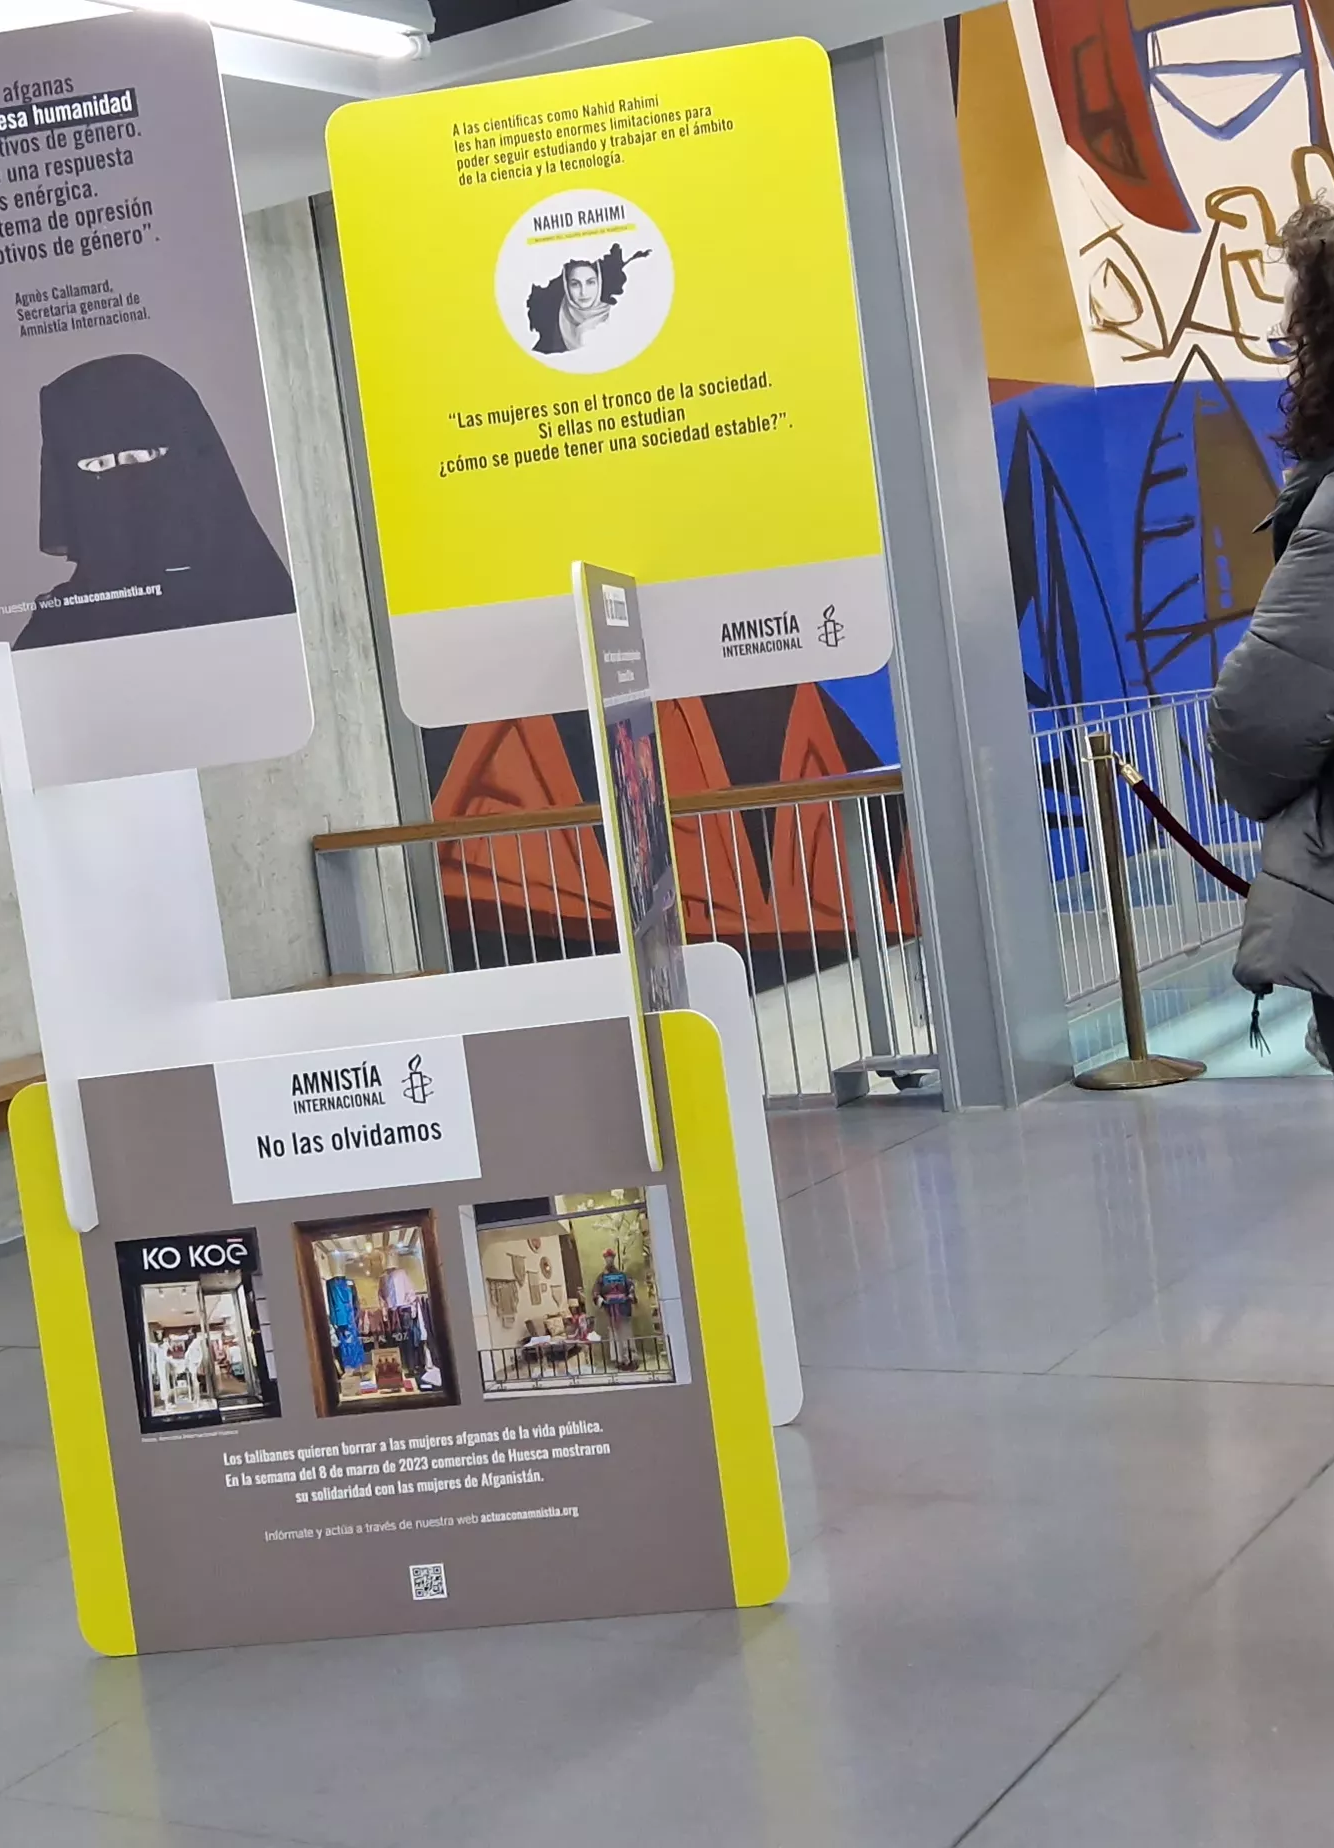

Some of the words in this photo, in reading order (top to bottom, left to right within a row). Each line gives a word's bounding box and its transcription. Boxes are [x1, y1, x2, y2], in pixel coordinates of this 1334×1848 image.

[2, 77, 74, 103] afganas
[32, 90, 132, 125] humanidad
[452, 123, 460, 136] A
[462, 121, 480, 135] las
[482, 113, 543, 132] científicas
[546, 108, 578, 122] como
[581, 100, 615, 117] Nahid
[618, 95, 659, 112] Rahimi
[45, 128, 67, 150] de
[72, 122, 141, 150] género.
[453, 139, 471, 153] les
[474, 136, 496, 150] han
[499, 128, 552, 146] impuesto
[555, 121, 606, 138] enormes
[609, 110, 681, 130] limitaciones
[684, 105, 711, 122] para
[456, 154, 489, 172] poder
[493, 147, 529, 165] seguir
[532, 137, 597, 158] estudiando
[599, 138, 606, 151] y
[609, 130, 656, 147] trabajar
[660, 128, 675, 140] en
[678, 123, 689, 137] el
[693, 118, 733, 135] ámbito
[6, 163, 39, 183] una
[44, 146, 133, 177] respuesta
[458, 172, 472, 186] de
[475, 170, 487, 183] la
[489, 165, 532, 181] ciencia
[535, 164, 542, 177] y
[545, 160, 556, 173] la
[559, 153, 624, 171] tecnología.
[13, 182, 98, 208] enérgica.
[47, 209, 68, 230] de
[74, 198, 152, 229] opresión
[533, 212, 573, 231] NAHID
[577, 204, 625, 225] RAHIMI
[52, 235, 74, 256] de
[16, 303, 77, 321] Secretaría
[79, 292, 123, 314] general
[125, 291, 140, 305] de
[51, 279, 113, 300] Callamard,
[19, 319, 68, 337] Amnistía
[70, 306, 150, 330] Internacional.
[487, 404, 548, 425] mujeres
[552, 400, 579, 416] son
[583, 393, 597, 411] el
[601, 390, 652, 409] tronco
[656, 384, 675, 402] de
[679, 382, 693, 398] la
[698, 370, 772, 396] sociedad.
[538, 421, 552, 439] Si
[557, 418, 593, 437] ellas
[597, 417, 615, 431] no
[620, 406, 685, 428] estudian
[439, 454, 487, 477] ¿cómo
[491, 452, 509, 467] se
[513, 443, 559, 468] puede
[563, 440, 603, 457] tener
[608, 435, 636, 451] una
[641, 422, 709, 447] sociedad
[38, 596, 61, 609] web
[62, 583, 162, 606] actuaconamnistia.org
[721, 610, 800, 642] AMNISTÍA
[722, 636, 802, 658] INTERNACIONAL
[291, 1060, 382, 1096] AMNISTÍA
[292, 1091, 385, 1114] INTERNACIONAL
[256, 1134, 285, 1158] No
[291, 1131, 324, 1155] las
[331, 1121, 441, 1150] olvidamos
[142, 1246, 180, 1269] KO
[222, 1452, 242, 1466] Los
[243, 1448, 295, 1464] talibanes
[296, 1444, 339, 1461] quieren
[340, 1441, 377, 1455] borrar
[378, 1440, 387, 1452] a
[388, 1437, 406, 1451] las
[407, 1434, 453, 1449] mujeres
[455, 1430, 500, 1446] afganas
[501, 1426, 516, 1440] de
[518, 1424, 529, 1439] la
[531, 1423, 556, 1438] vida
[557, 1419, 603, 1438] pública.
[224, 1473, 239, 1487] En
[240, 1472, 252, 1485] la
[254, 1471, 296, 1484] semana
[298, 1466, 316, 1481] del
[318, 1464, 327, 1479] 8
[328, 1464, 343, 1478] de
[345, 1463, 380, 1476] marzo
[381, 1459, 396, 1473] de
[398, 1455, 428, 1472] 2023
[430, 1452, 489, 1469] comercios
[491, 1449, 505, 1463] de
[507, 1448, 549, 1462] Huesca
[551, 1443, 610, 1458] mostraron
[294, 1491, 308, 1503] su
[310, 1482, 372, 1501] solidaridad
[374, 1484, 395, 1496] con
[396, 1480, 414, 1494] las
[416, 1477, 462, 1493] mujeres
[463, 1473, 478, 1488] de
[480, 1468, 544, 1488] Afganistán.
[315, 1528, 322, 1539] y
[355, 1524, 362, 1533] a
[364, 1520, 397, 1532] través
[398, 1519, 412, 1529] de
[414, 1516, 454, 1529] nuestra
[456, 1513, 478, 1524] web
[480, 1506, 579, 1523] actuaconamnistia.org
